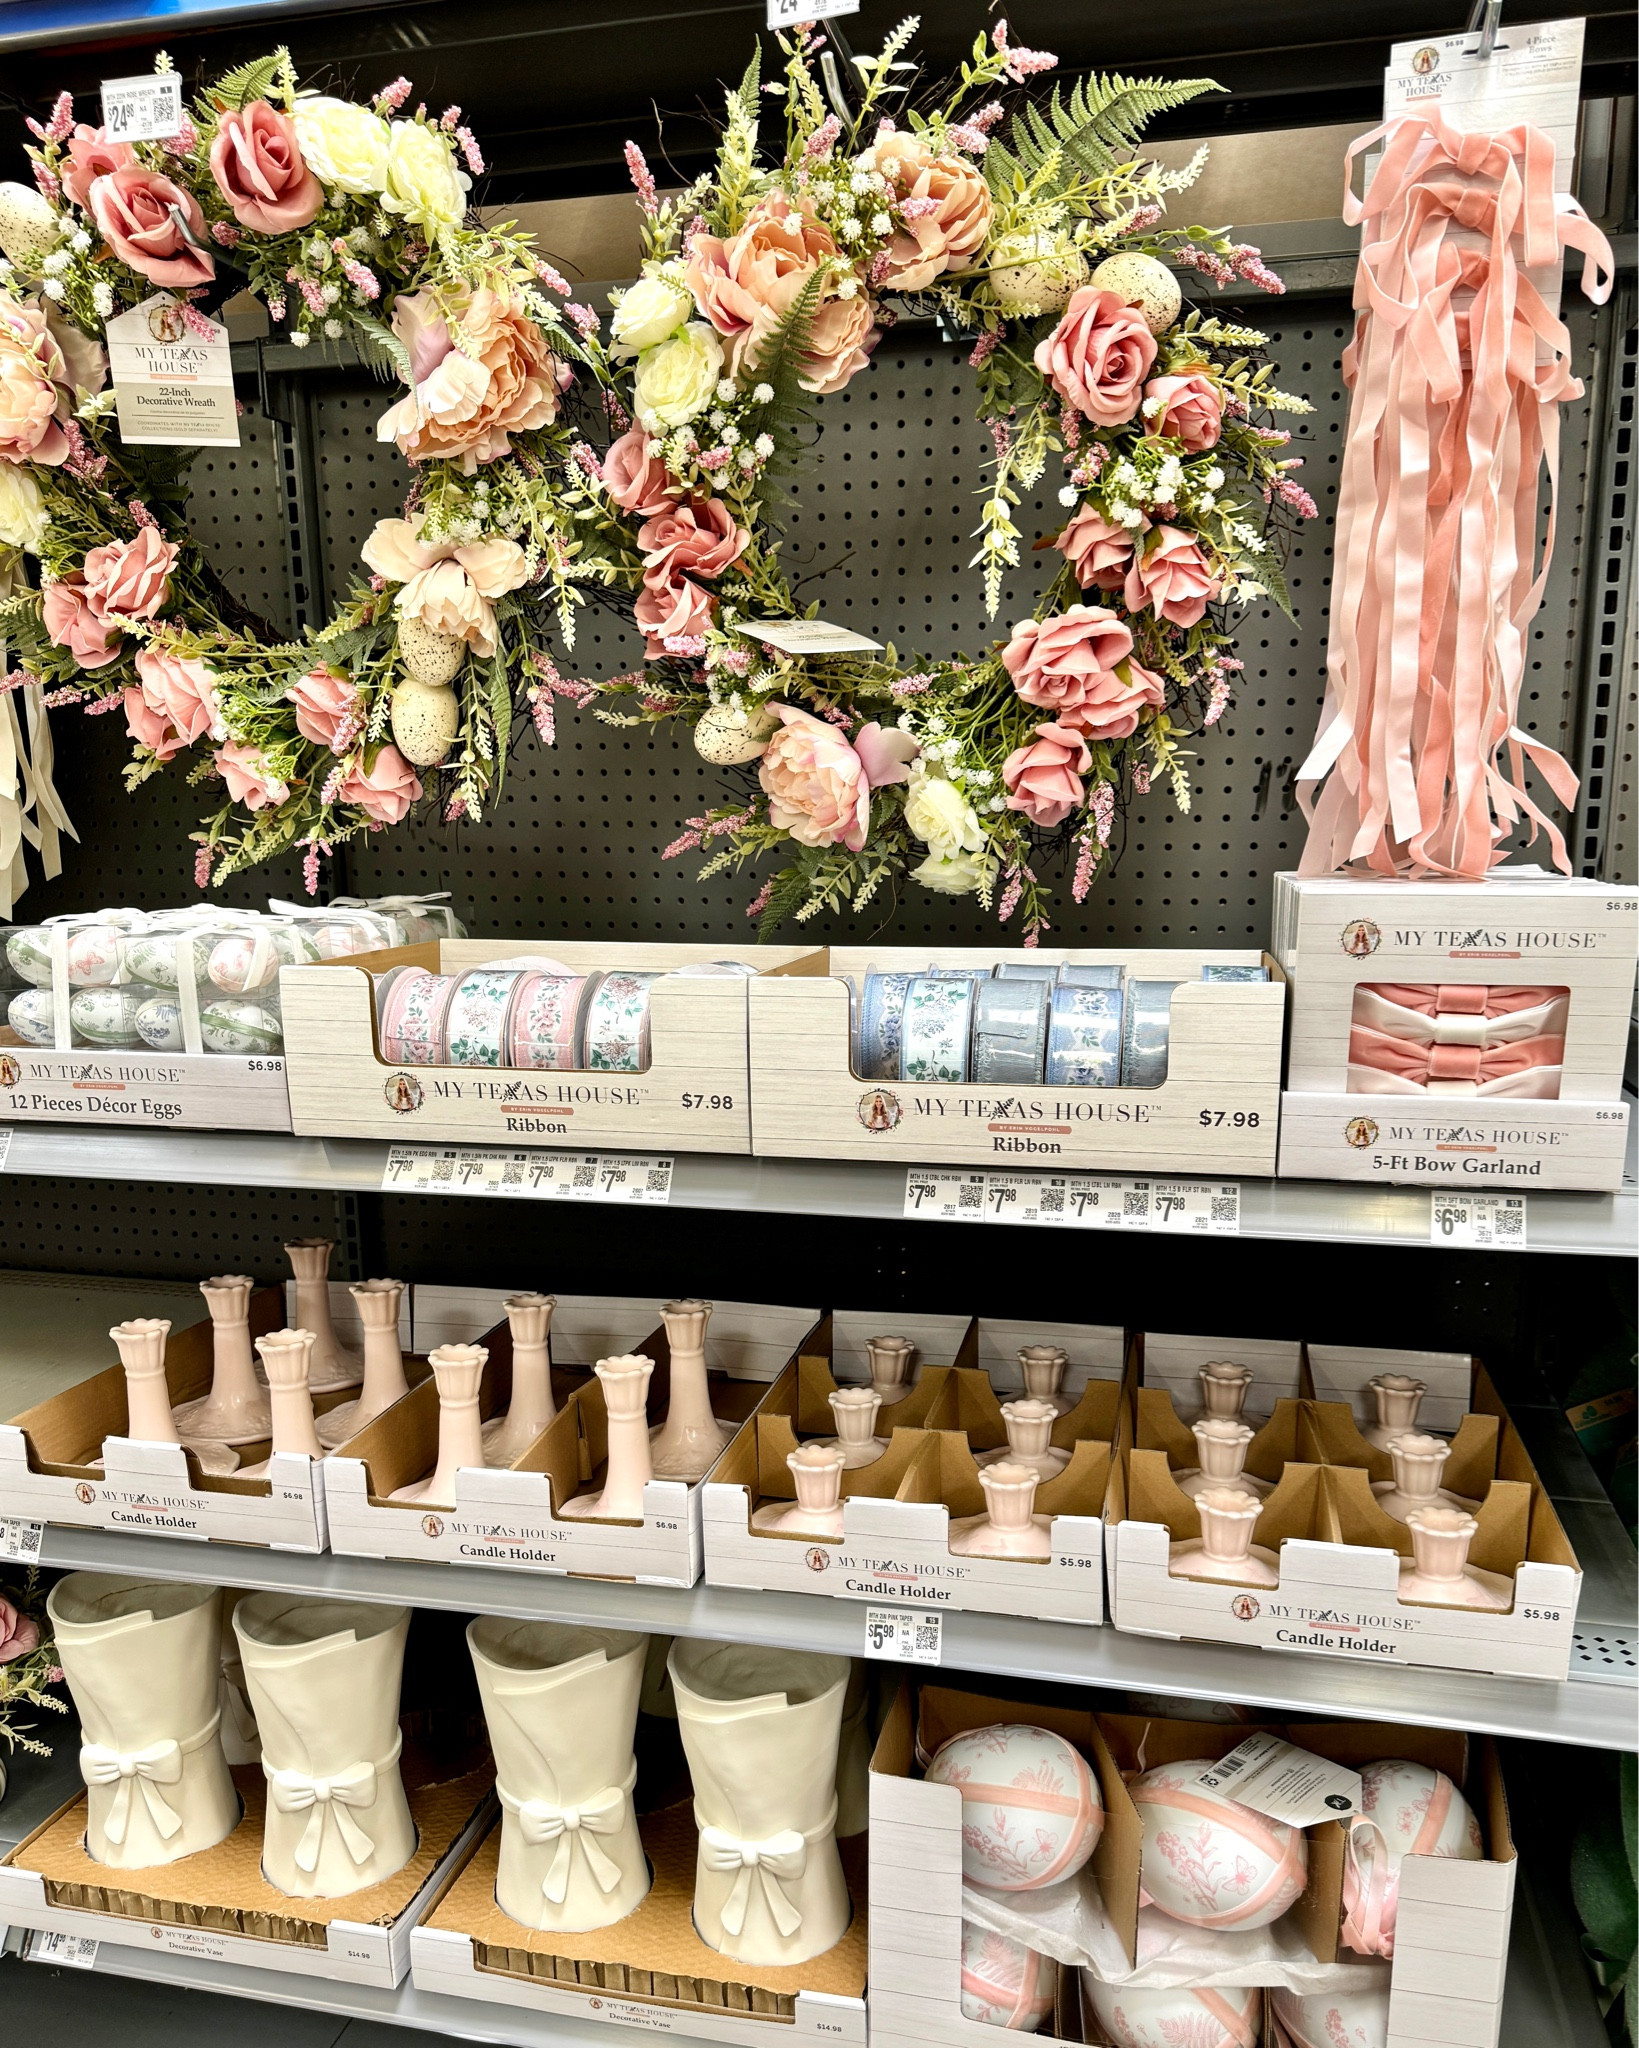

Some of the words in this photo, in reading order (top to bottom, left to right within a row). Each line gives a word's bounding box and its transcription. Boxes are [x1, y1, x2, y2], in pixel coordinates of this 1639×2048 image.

[1445, 39, 1464, 48] $6.98
[1533, 34, 1557, 45] Piece
[1529, 45, 1552, 54] Bows
[1398, 78, 1413, 89] MY
[1416, 73, 1452, 87] TEXAS
[135, 347, 158, 359] MY
[160, 347, 208, 361] TEXAS
[159, 387, 191, 397] 22-Inch
[137, 396, 183, 406] Decorative
[184, 397, 216, 407] Wreath
[1606, 901, 1638, 911] $6.98
[1394, 930, 1428, 947] MY
[1434, 929, 1507, 949] TEXAS
[30, 1064, 52, 1078] MY
[58, 1063, 113, 1080] TEXAS
[248, 1060, 282, 1072] $6.98
[433, 1081, 464, 1099] MY
[473, 1080, 548, 1103] TEXAS
[10, 1094, 28, 1110] 12
[32, 1095, 83, 1112] Pieces
[87, 1095, 137, 1114] Décor
[142, 1098, 182, 1120] Eggs
[681, 1093, 733, 1110] $7.98
[913, 1098, 948, 1117] MY
[959, 1097, 1043, 1121] TEXAS
[1199, 1109, 1260, 1128] $7.98
[1596, 1111, 1624, 1120] $6.98
[506, 1117, 568, 1134] Ribbon
[1389, 1127, 1417, 1140] MY
[1423, 1127, 1485, 1143] TEXAS
[992, 1136, 1062, 1155] Ribbon
[1372, 1155, 1409, 1170] 5-Ft
[1414, 1156, 1456, 1172] Bow
[1462, 1158, 1541, 1175] Garland
[1200, 1186, 1212, 1194] RBN
[1459, 1197, 1472, 1205] BOW
[1473, 1198, 1500, 1206] GARLAND
[1476, 1213, 1487, 1221] NA
[102, 1489, 118, 1501] MY
[121, 1491, 159, 1505] TEXAS
[283, 1491, 303, 1500] $6.98
[111, 1510, 152, 1525] Candle
[154, 1514, 198, 1529] Holder
[655, 1520, 678, 1530] $6.98
[451, 1522, 469, 1534] MY
[473, 1524, 516, 1538] TEXAS
[460, 1543, 506, 1559] Candle
[509, 1547, 556, 1562] Holder
[838, 1556, 857, 1568] MY
[862, 1558, 908, 1574] TEXAS
[1060, 1557, 1092, 1569] $5.98
[845, 1578, 896, 1595] Candle
[900, 1584, 951, 1600] Holder
[899, 1614, 914, 1622] TAPER
[1269, 1604, 1291, 1617] MY
[1298, 1606, 1350, 1623] TEXAS
[1523, 1608, 1560, 1621] $5.98
[1276, 1628, 1334, 1648] Candle
[1338, 1635, 1397, 1654] Holder
[165, 1930, 175, 1938] MY
[169, 1941, 206, 1954] Decorative
[207, 1947, 224, 1957] Vase
[347, 1950, 371, 1960] $14.98
[606, 2001, 618, 2010] MY
[619, 2004, 646, 2015] TEXAS
[609, 2012, 651, 2027] Decorative
[652, 2019, 671, 2029] Vase
[816, 2022, 842, 2032] $14.98
